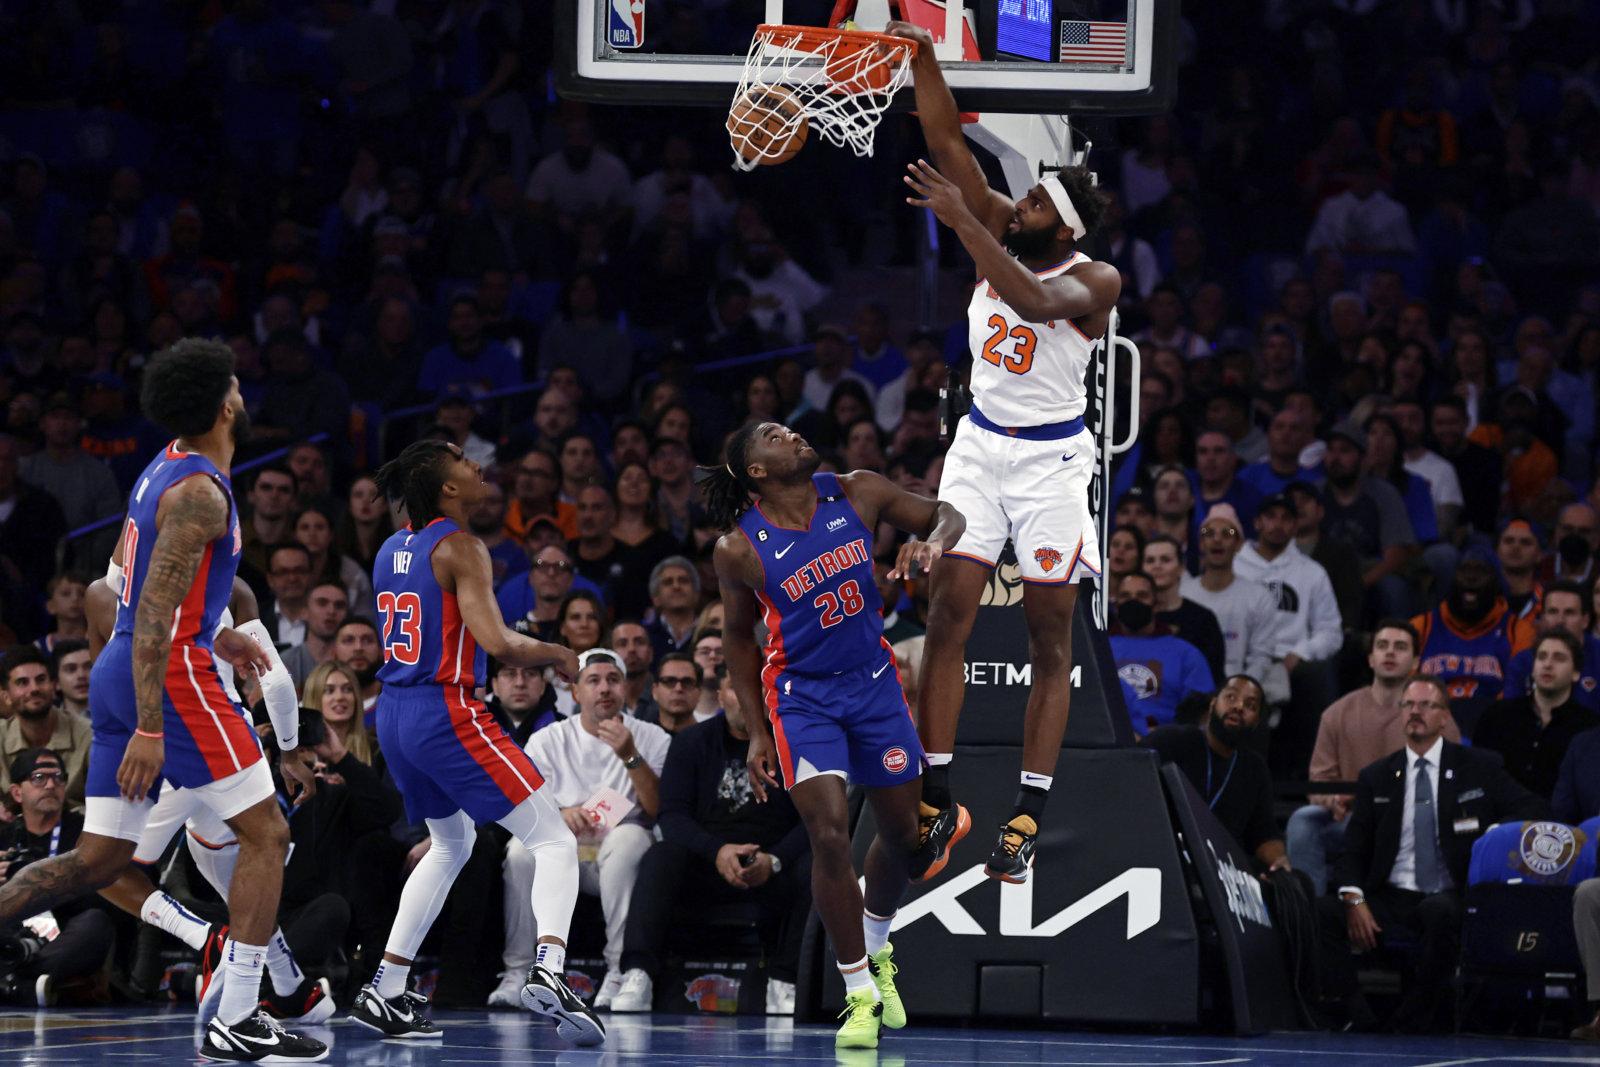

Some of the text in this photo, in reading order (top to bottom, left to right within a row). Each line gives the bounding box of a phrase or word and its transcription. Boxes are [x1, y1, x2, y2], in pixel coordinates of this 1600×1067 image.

[613, 29, 630, 43] NBA
[981, 313, 1038, 375] 23
[826, 516, 847, 530] UWM
[758, 530, 768, 541] 6
[393, 551, 413, 574] IVEY
[780, 538, 869, 602] DETROIT
[813, 579, 864, 629] 28
[377, 591, 422, 665] 23
[1517, 931, 1540, 952] 15
